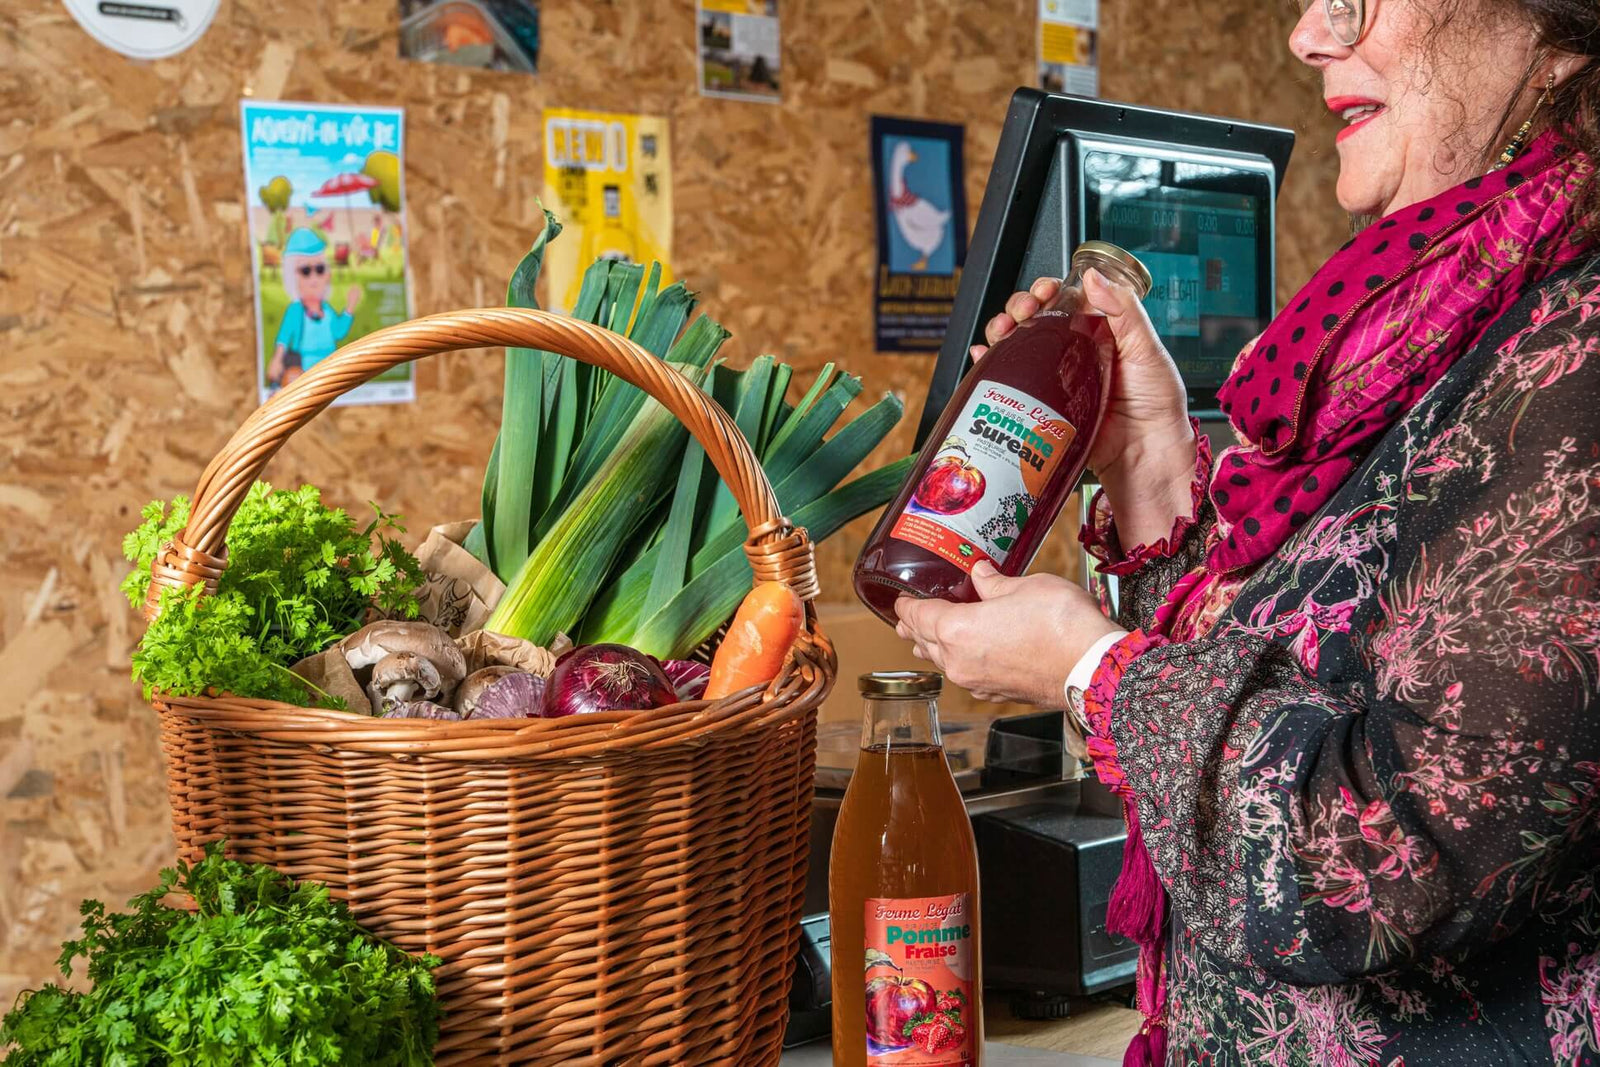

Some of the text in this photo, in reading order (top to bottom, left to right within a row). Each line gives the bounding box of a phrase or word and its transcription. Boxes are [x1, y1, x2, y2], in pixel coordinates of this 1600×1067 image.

[983, 387, 1066, 440] Ferme Légat
[1006, 411, 1016, 420] JUS
[972, 403, 1054, 458] Pomme
[968, 419, 1045, 472] Sureau
[875, 903, 962, 923] Ferme Légat
[886, 924, 971, 944] Pomme
[905, 943, 957, 959] Fraise
